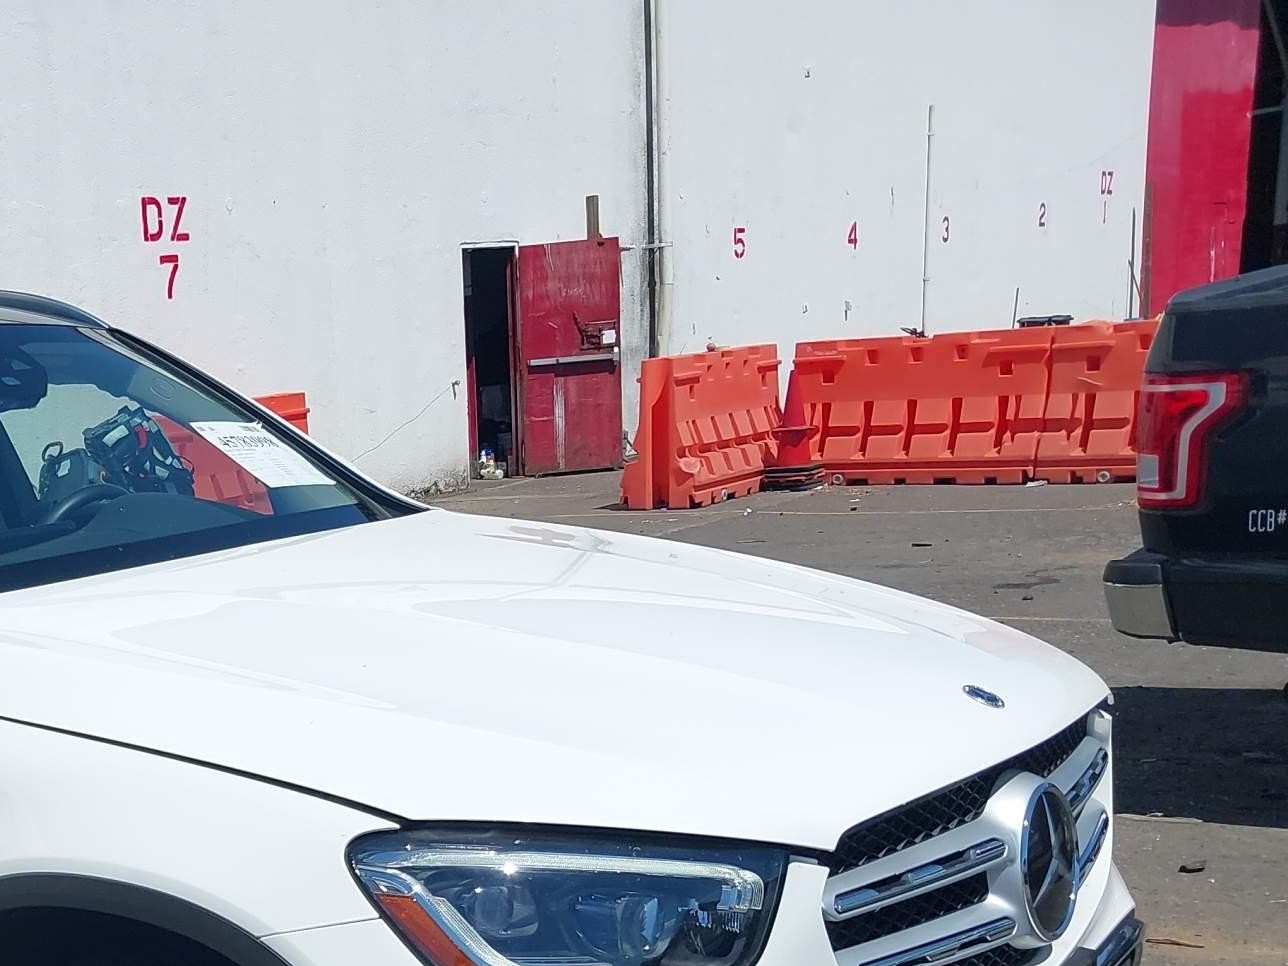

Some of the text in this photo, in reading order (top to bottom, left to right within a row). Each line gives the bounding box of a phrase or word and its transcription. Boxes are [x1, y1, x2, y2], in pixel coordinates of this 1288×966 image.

[1100, 170, 1114, 195] DZ
[140, 196, 190, 242] DZ
[941, 215, 950, 243] 3
[1038, 202, 1046, 227] 2
[733, 227, 746, 259] 5
[847, 220, 859, 250] 4
[159, 253, 179, 300] 7
